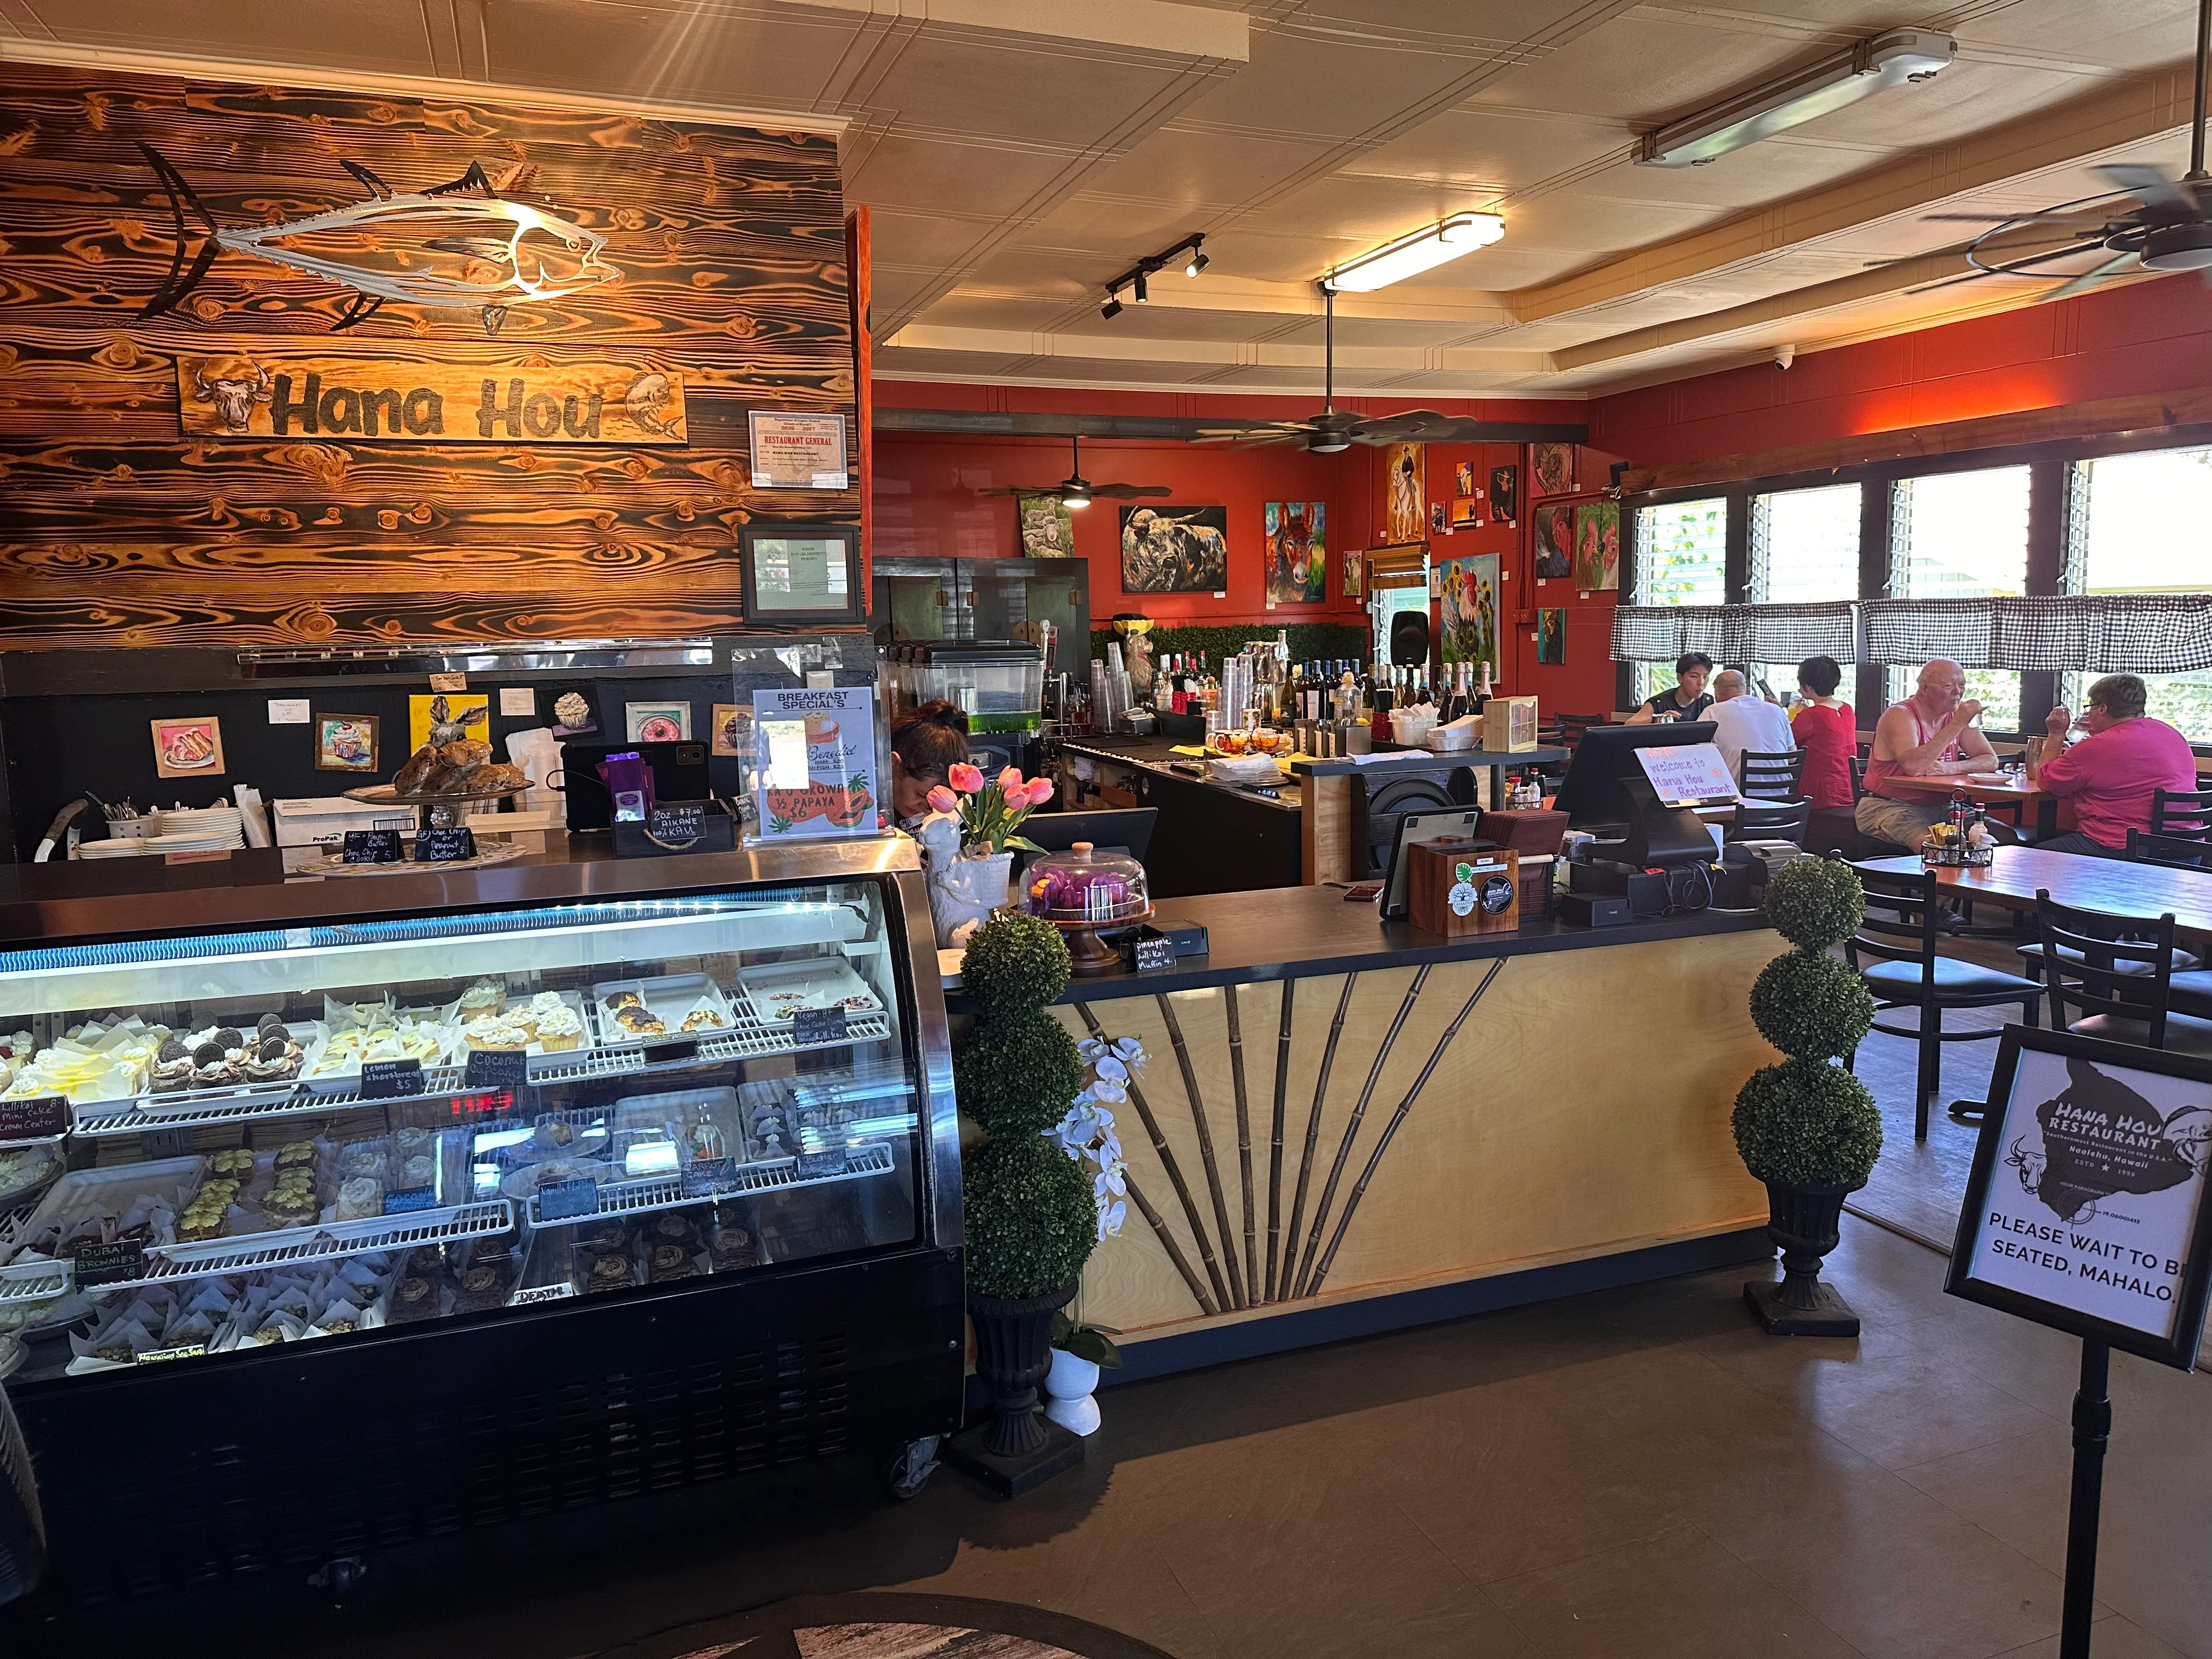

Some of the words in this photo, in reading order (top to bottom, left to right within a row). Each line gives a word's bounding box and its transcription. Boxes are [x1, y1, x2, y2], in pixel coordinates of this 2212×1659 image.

[269, 374, 444, 436] Hana
[476, 378, 603, 439] Hou
[764, 436, 804, 444] RESTAURANT
[777, 691, 849, 702] BREAKFAST
[782, 699, 845, 709] SPECIAL'S
[808, 744, 856, 761] Benedict
[1650, 760, 1692, 773] welcome
[1694, 758, 1705, 768] to
[1652, 776, 1683, 787] Hana
[1684, 774, 1704, 785] Hou
[1678, 783, 1731, 798] Restaurant
[795, 797, 835, 808] PAPAYA
[789, 806, 807, 819] $6
[662, 817, 698, 827] AIKANE
[431, 841, 459, 849] Peanut
[430, 850, 458, 860] Butter
[1138, 959, 1163, 970] Muffin
[24, 1117, 55, 1128] Center
[2055, 1102, 2108, 1126] HANA
[2115, 1114, 2162, 1136] HOU
[2049, 1117, 2162, 1150] RESTAURANT
[2091, 1141, 2126, 1153] Restaurant
[2136, 1150, 2147, 1158] the
[2068, 1145, 2112, 1162] Naalehu,
[2114, 1155, 2149, 1170] Hawaii
[686, 1170, 713, 1178] CAKE
[2074, 1158, 2095, 1168] ESTD
[2117, 1168, 2135, 1177] 1995
[540, 1182, 566, 1195] Vanilla
[2074, 1184, 2105, 1196] PARAGRAPH
[1989, 1212, 2064, 1245] PLEASE
[2069, 1233, 2124, 1260] WAIT
[2129, 1249, 2158, 1269] TO
[77, 1254, 136, 1270] BROWNIES
[1991, 1239, 2072, 1277] SEATED,
[2079, 1263, 2176, 1304] MAHALO.
